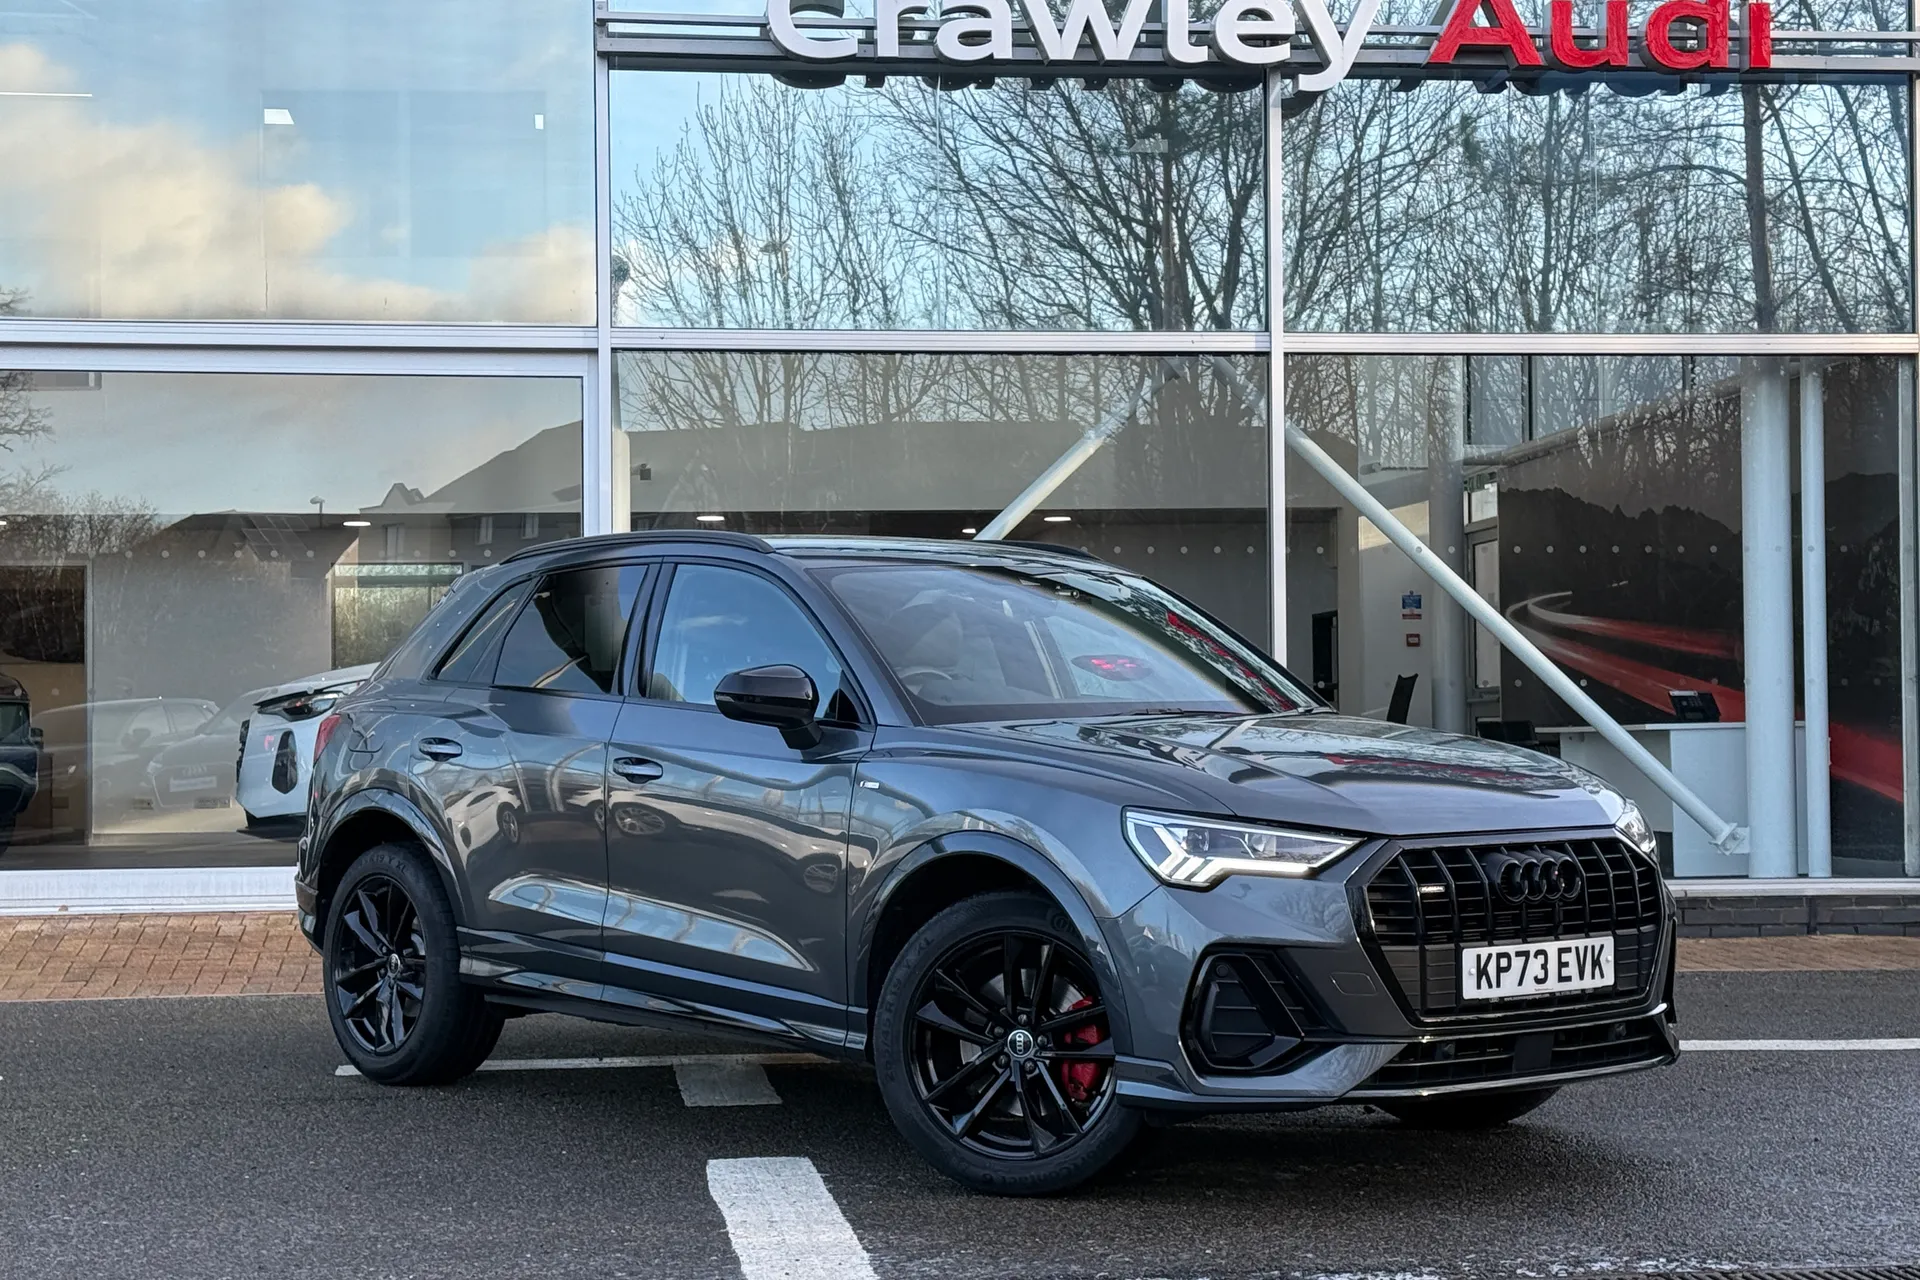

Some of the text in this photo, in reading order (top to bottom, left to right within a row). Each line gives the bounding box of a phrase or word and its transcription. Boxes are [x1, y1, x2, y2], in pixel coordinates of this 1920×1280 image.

[766, 0, 1771, 93] Crawley Audi
[1476, 943, 1605, 990] KP73 EVK
